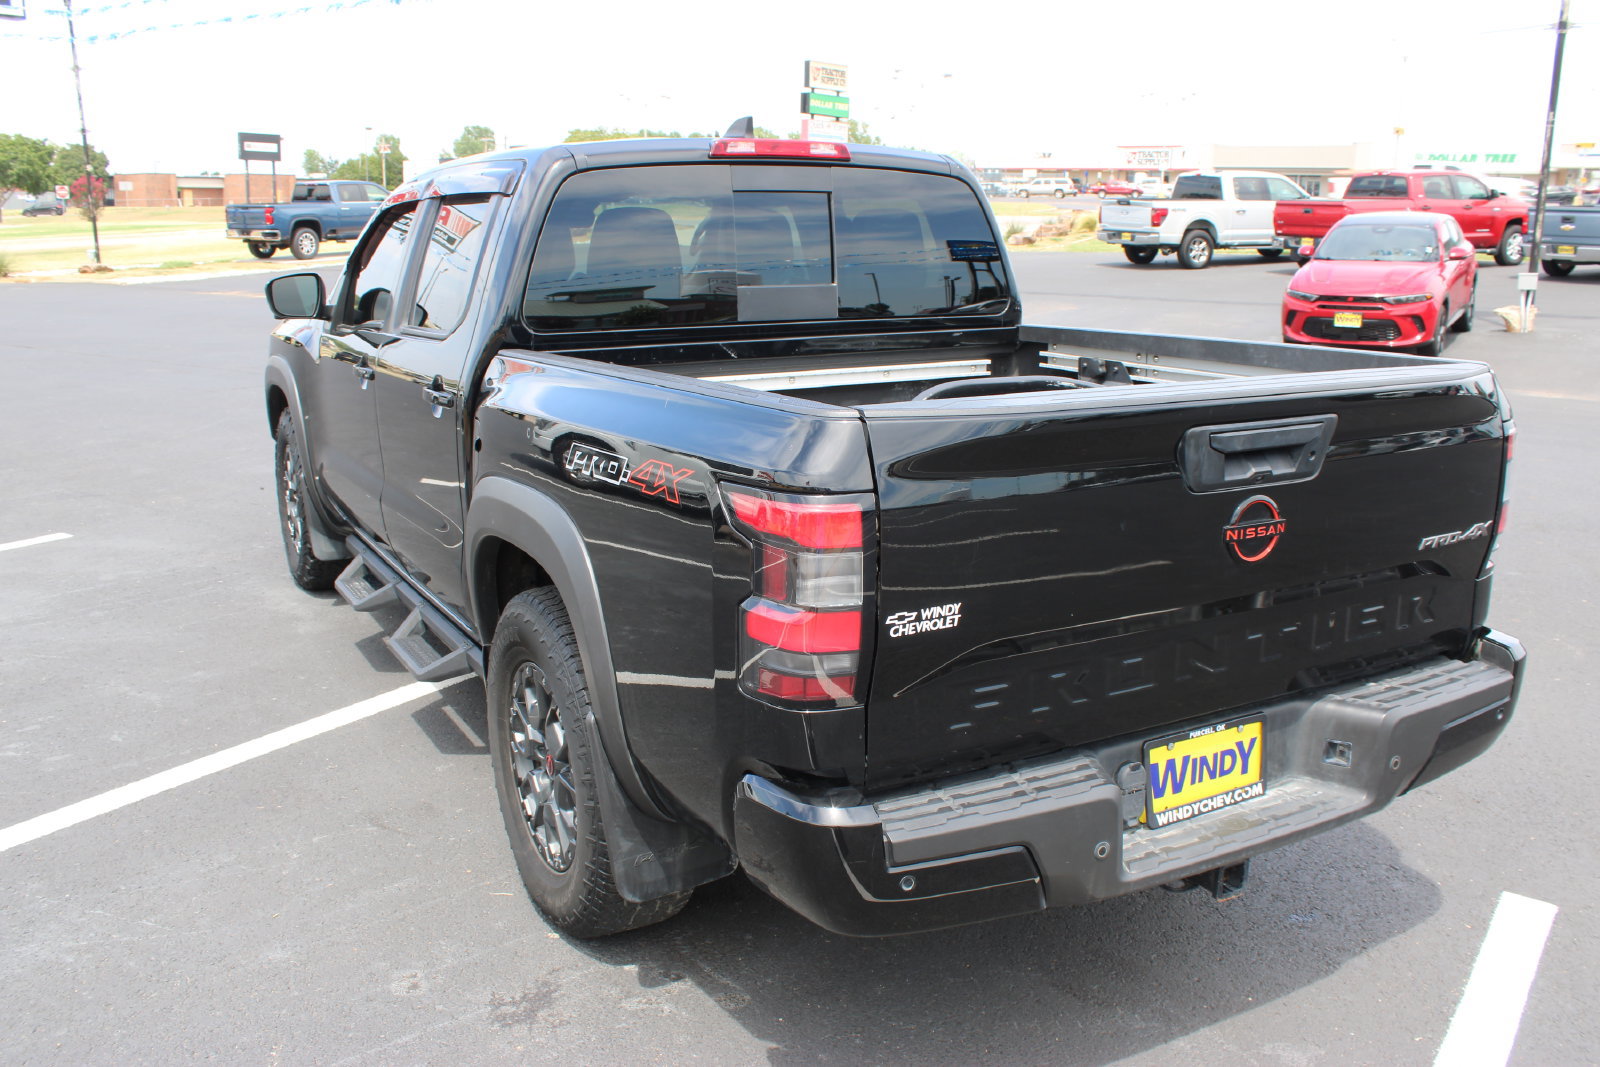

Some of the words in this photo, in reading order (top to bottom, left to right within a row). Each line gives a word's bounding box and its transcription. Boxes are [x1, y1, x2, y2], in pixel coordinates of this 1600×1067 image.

[1428, 153, 1477, 163] DOLLAR
[1485, 153, 1517, 164] TREE
[1226, 523, 1285, 541] NISSAN
[921, 602, 962, 620] WINDY
[889, 614, 962, 638] CHEVROLET
[947, 588, 1437, 722] FRONTIER
[1150, 736, 1258, 799] WINDY
[1156, 782, 1264, 826] WINDYCHEV.COM
